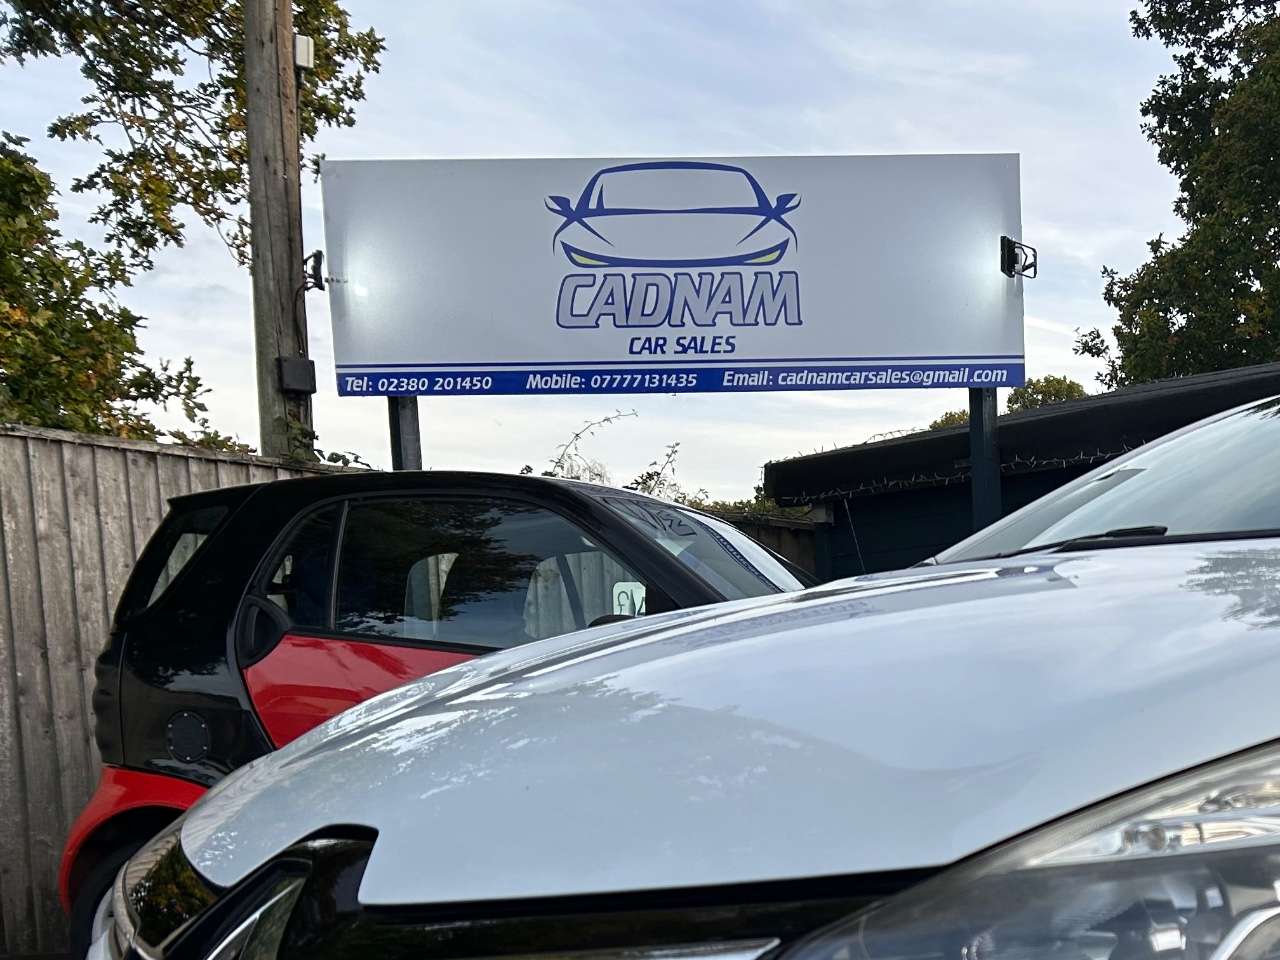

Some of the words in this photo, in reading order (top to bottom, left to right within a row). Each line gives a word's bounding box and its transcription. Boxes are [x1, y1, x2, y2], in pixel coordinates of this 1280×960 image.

[556, 271, 803, 329] CADNAM
[628, 336, 667, 355] CAR
[673, 335, 737, 355] SALES
[345, 376, 373, 392] Tel:
[378, 376, 429, 392] 02380
[433, 375, 493, 391] 201450
[526, 373, 586, 389] Mobile:
[590, 373, 698, 389] 07777131435
[722, 370, 774, 386] Email:
[778, 366, 1008, 386] cadnamcarsales@gmail.com
